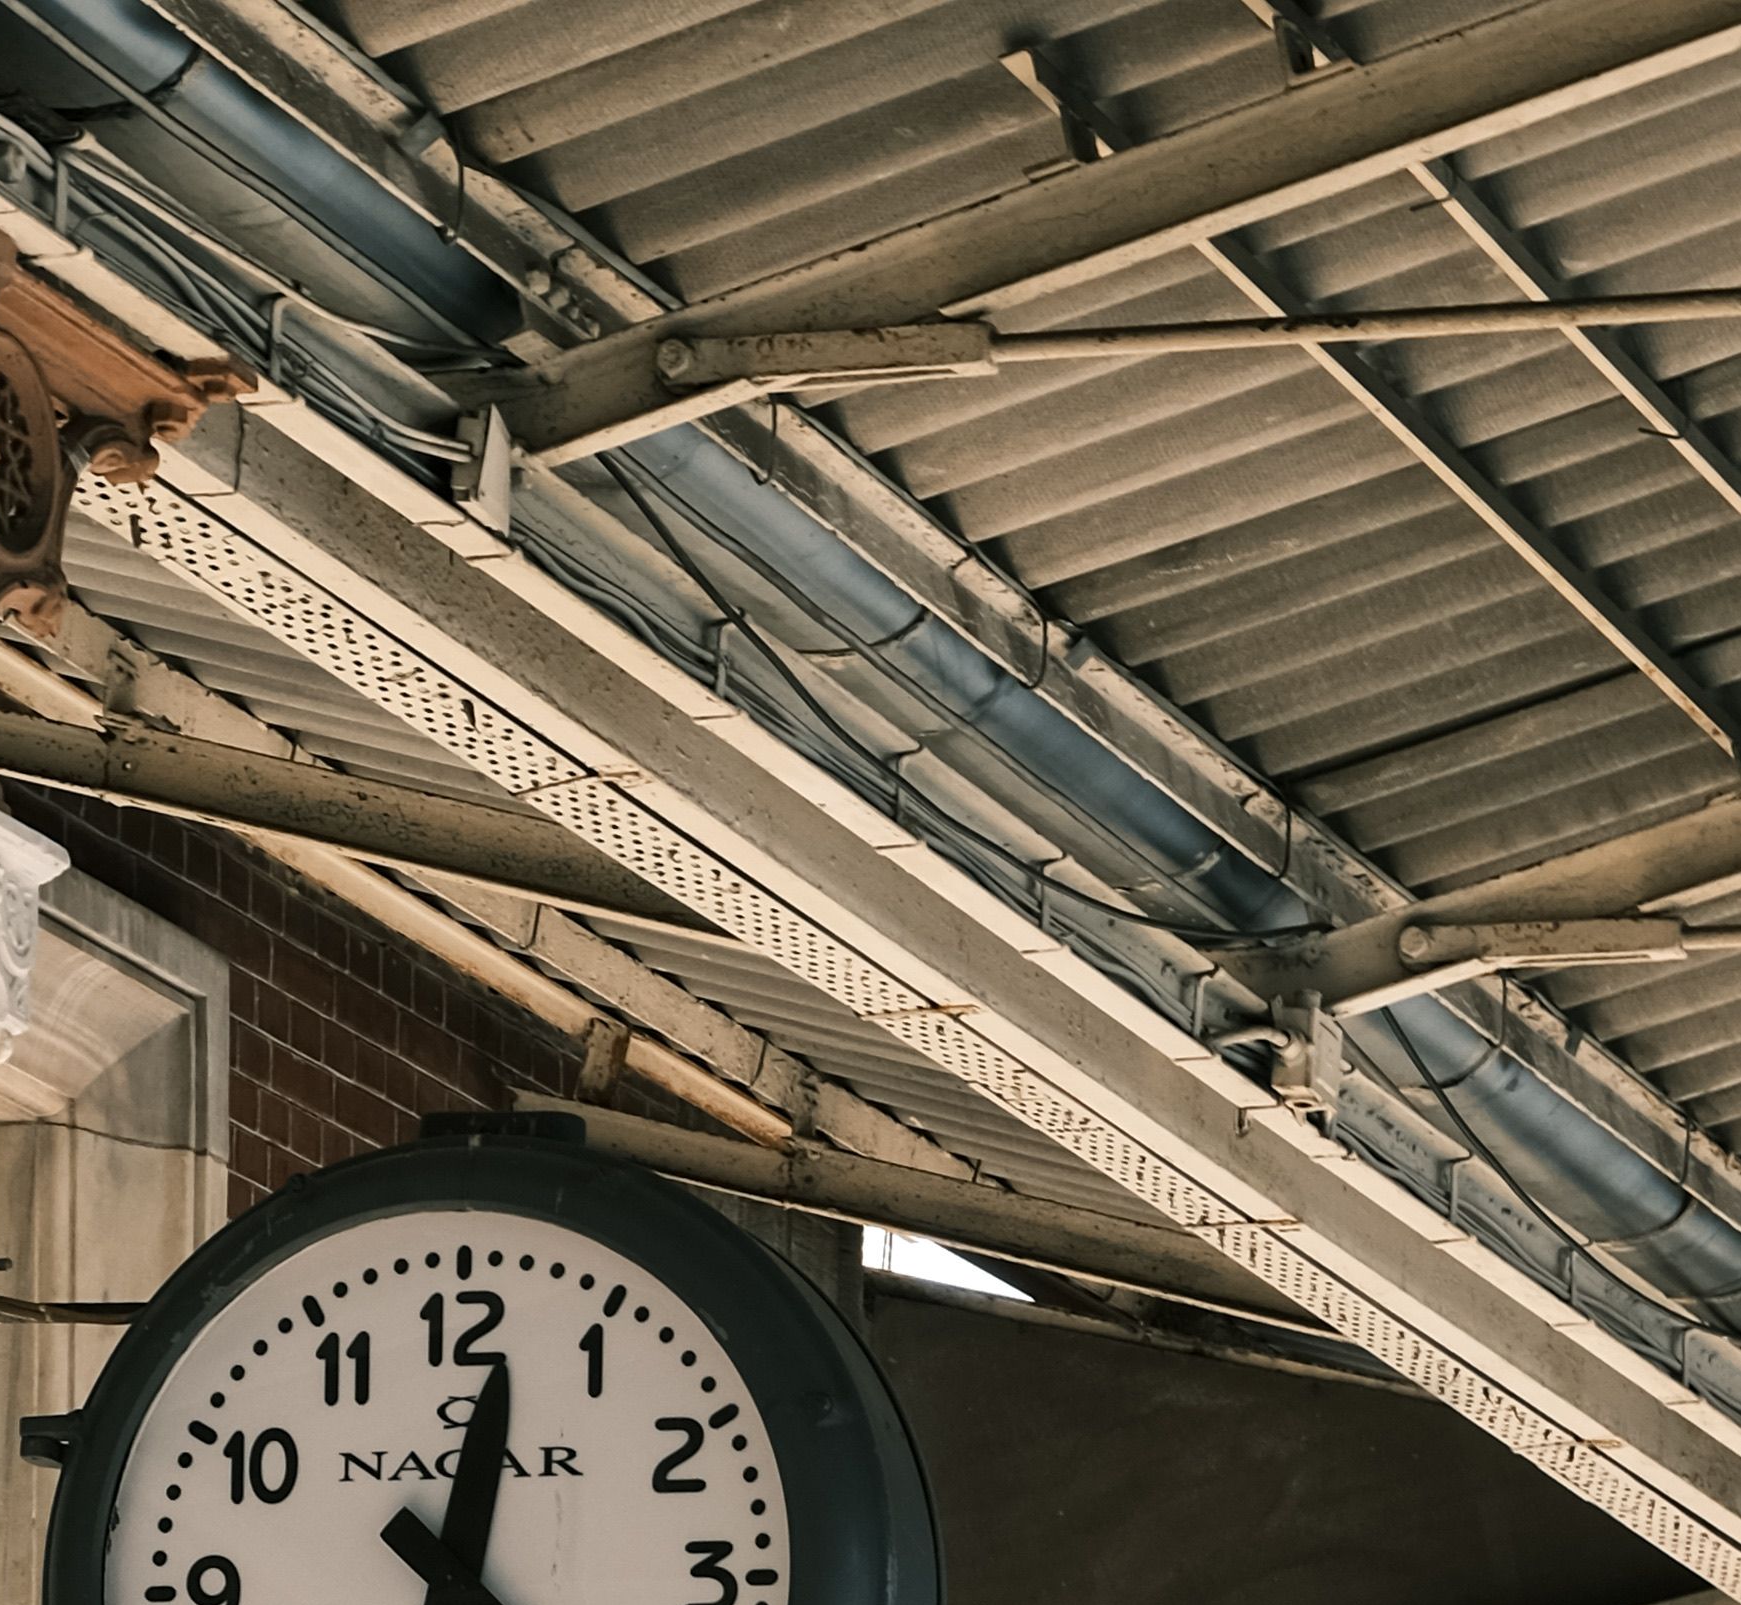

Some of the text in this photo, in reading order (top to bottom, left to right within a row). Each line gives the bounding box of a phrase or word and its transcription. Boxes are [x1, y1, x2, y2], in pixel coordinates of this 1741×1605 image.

[419, 1290, 507, 1368] 12
[578, 1322, 604, 1399] 1
[315, 1330, 371, 1407] 11
[222, 1427, 299, 1505] 10
[651, 1416, 707, 1494] 2
